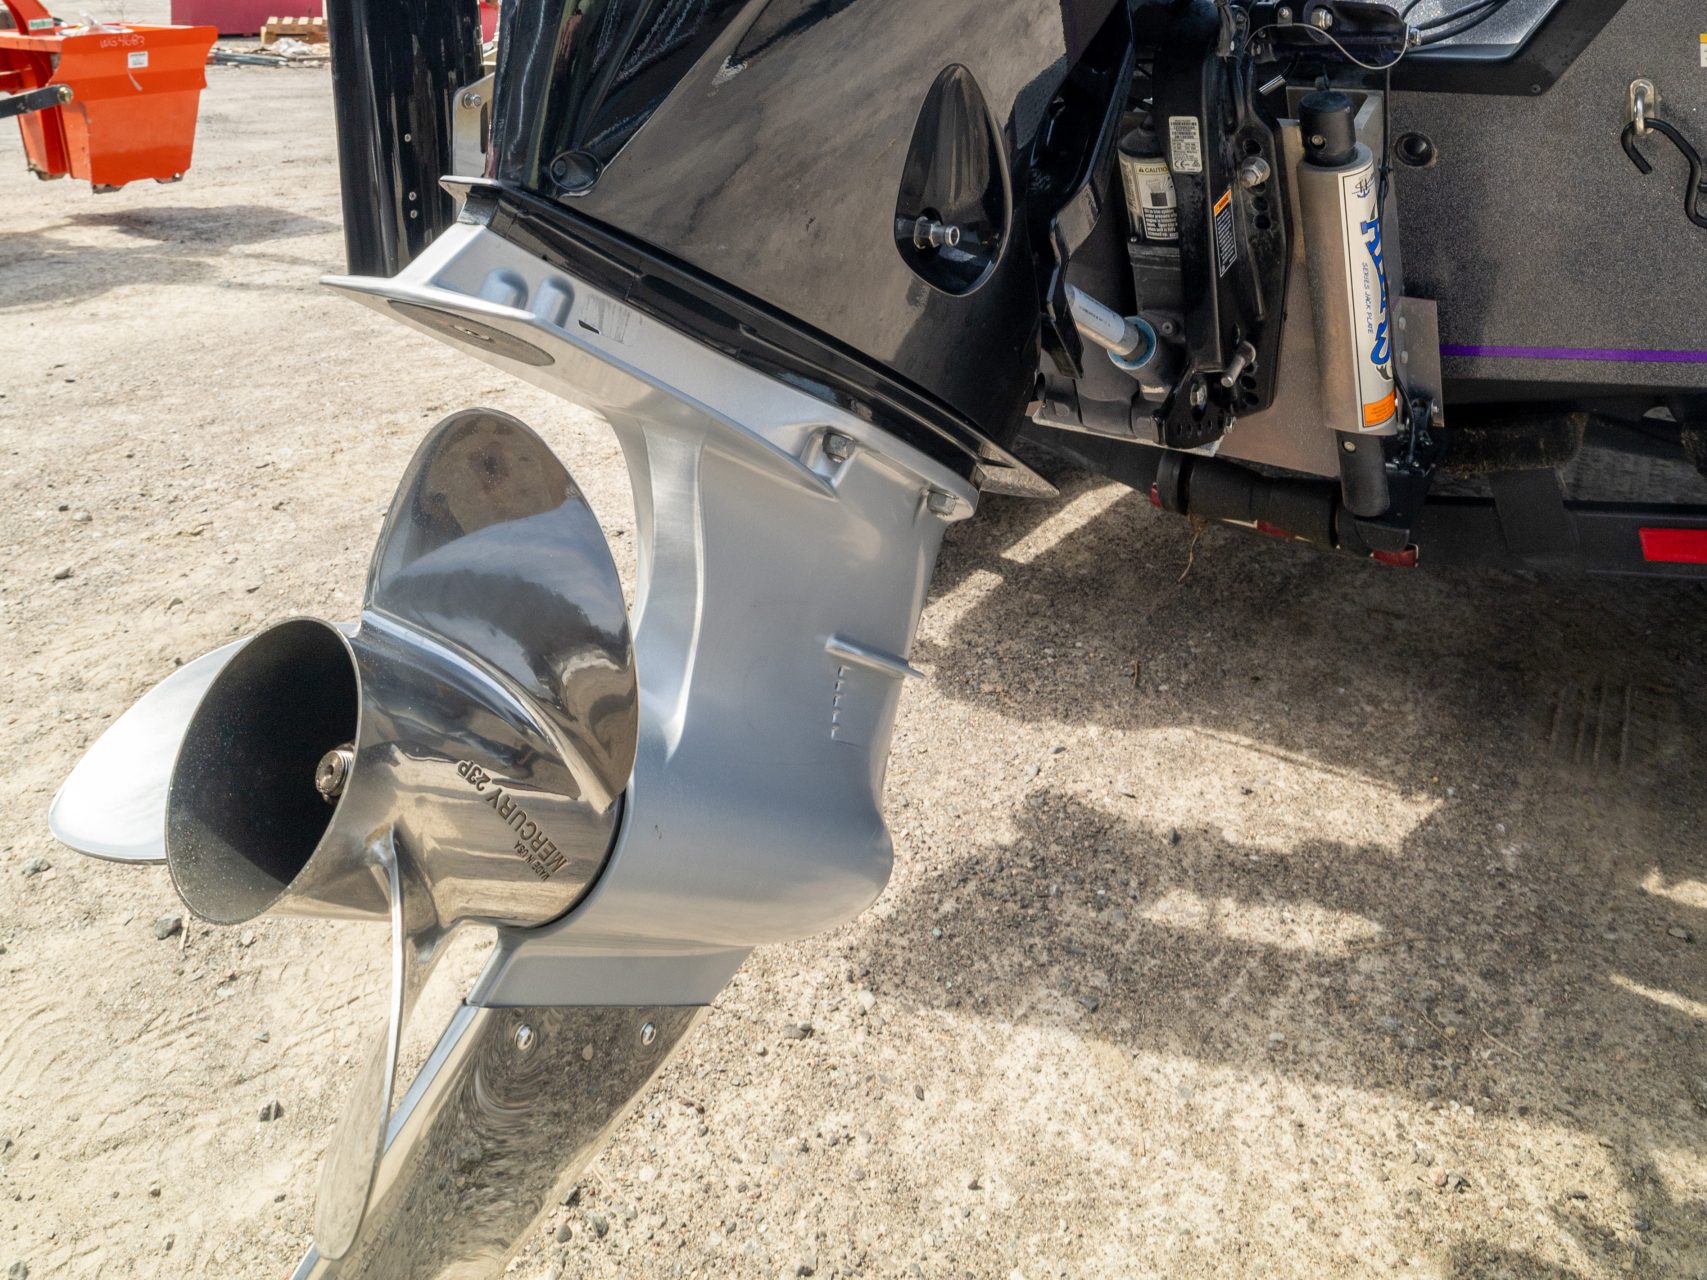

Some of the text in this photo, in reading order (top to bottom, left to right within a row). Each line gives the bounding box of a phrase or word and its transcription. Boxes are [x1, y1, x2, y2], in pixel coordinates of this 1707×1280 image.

[1361, 262, 1374, 334] SERIES JACK PLATE
[457, 760, 568, 873] MERCURY 23P
[513, 840, 551, 881] MADE IN USA
